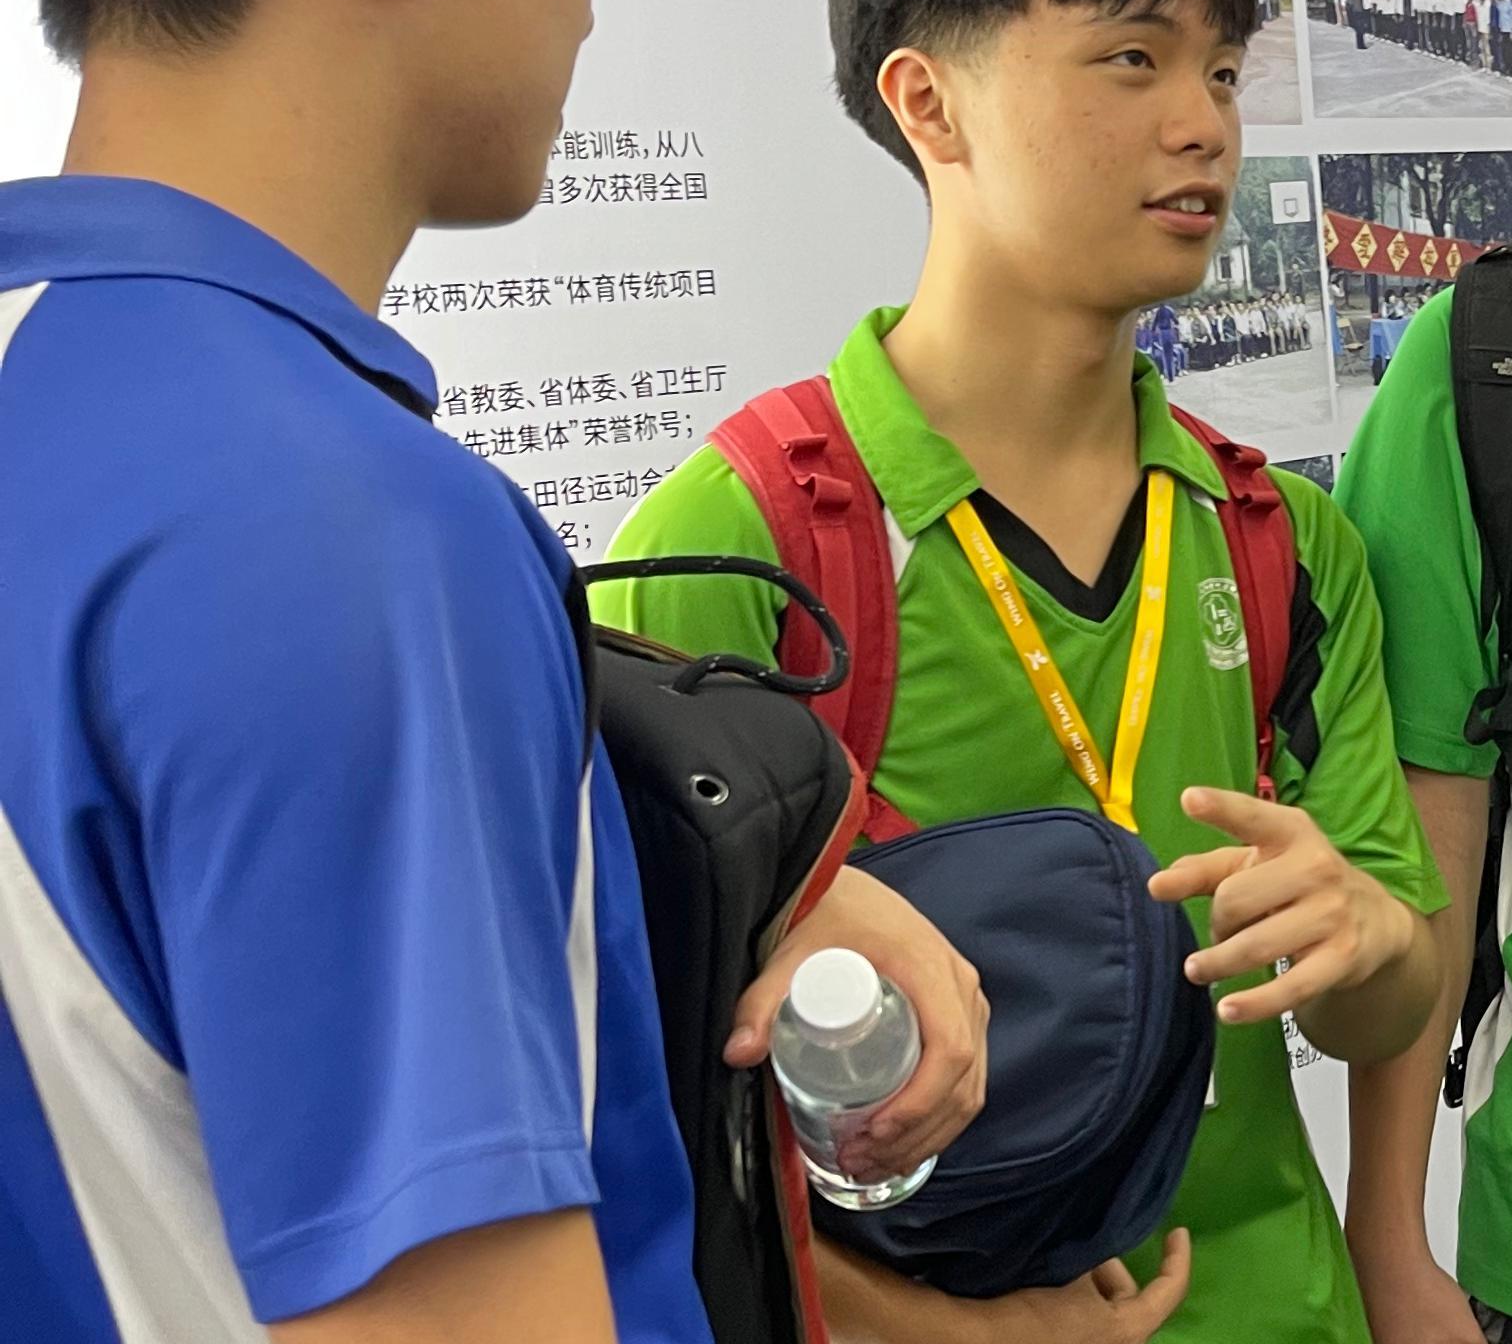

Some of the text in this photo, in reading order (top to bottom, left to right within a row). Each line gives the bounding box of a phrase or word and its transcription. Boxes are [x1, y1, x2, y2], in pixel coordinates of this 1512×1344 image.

[454, 410, 696, 459] 先进集体”荣誉称号；
[520, 466, 676, 508] 田径运动会
